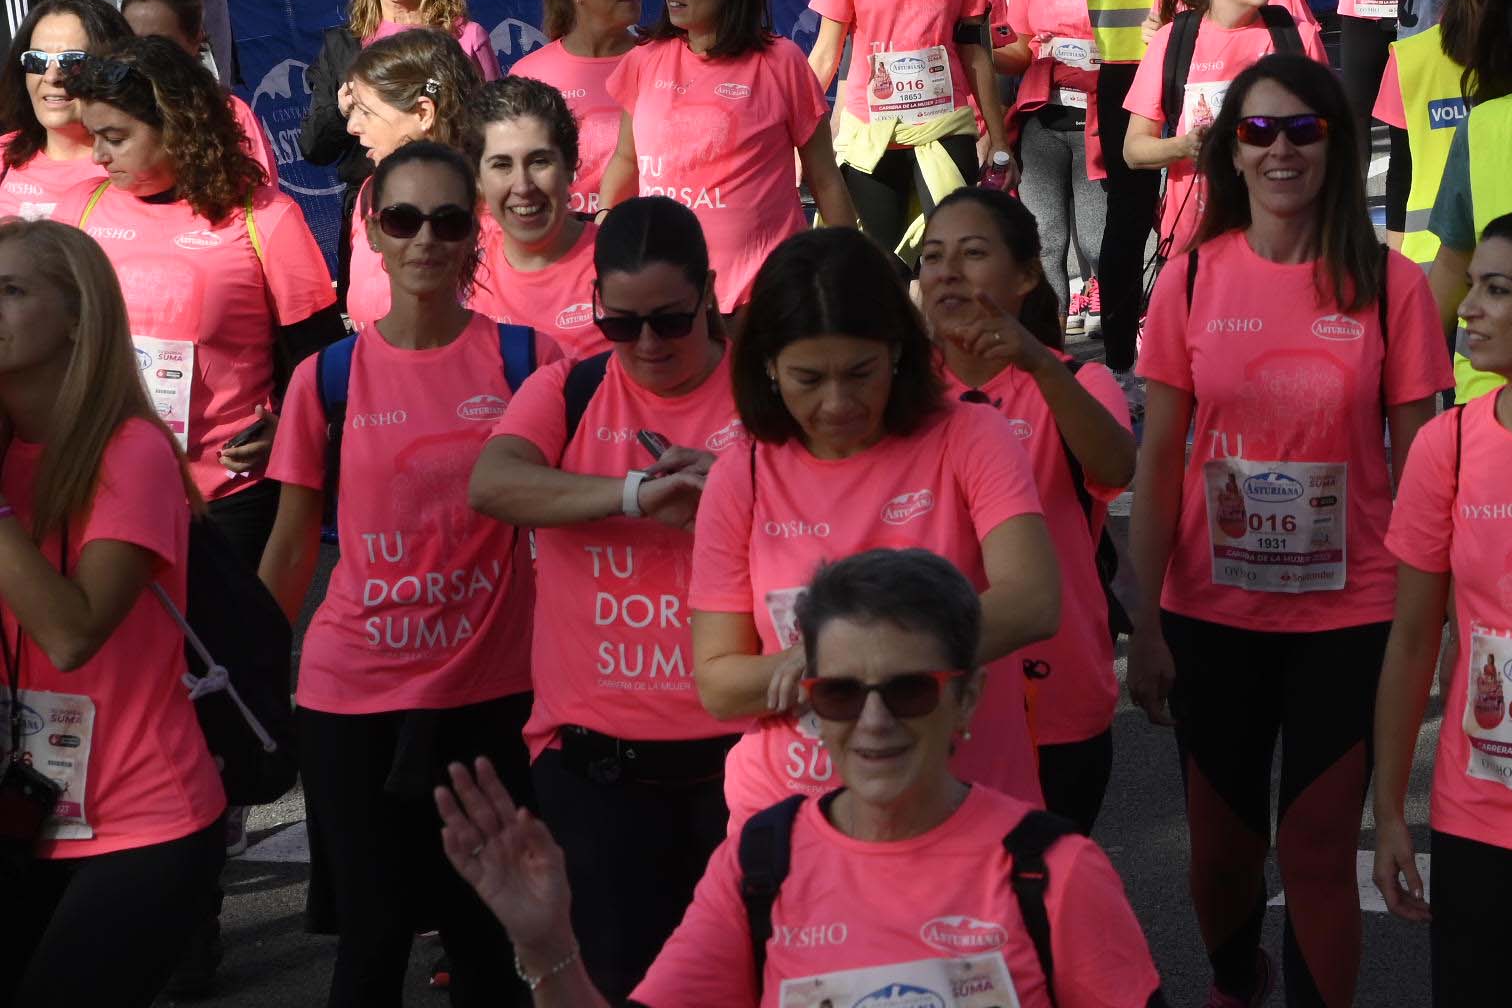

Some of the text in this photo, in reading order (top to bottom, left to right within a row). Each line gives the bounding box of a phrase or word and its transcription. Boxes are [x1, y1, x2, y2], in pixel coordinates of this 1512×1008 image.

[895, 79, 924, 92] 016
[900, 93, 923, 102] 18653
[640, 155, 664, 178] TU
[1207, 318, 1263, 334] OYSHO
[1314, 323, 1361, 336] ASTURIANA
[157, 354, 183, 363] SUMA
[1244, 479, 1301, 497] ASTURIANA
[1248, 513, 1297, 533] 016
[361, 531, 405, 564] TU
[1256, 537, 1287, 550] 1931
[584, 545, 633, 579] TU
[364, 616, 475, 651] SUMA
[597, 641, 693, 677] SUM
[50, 712, 84, 725] SUMA
